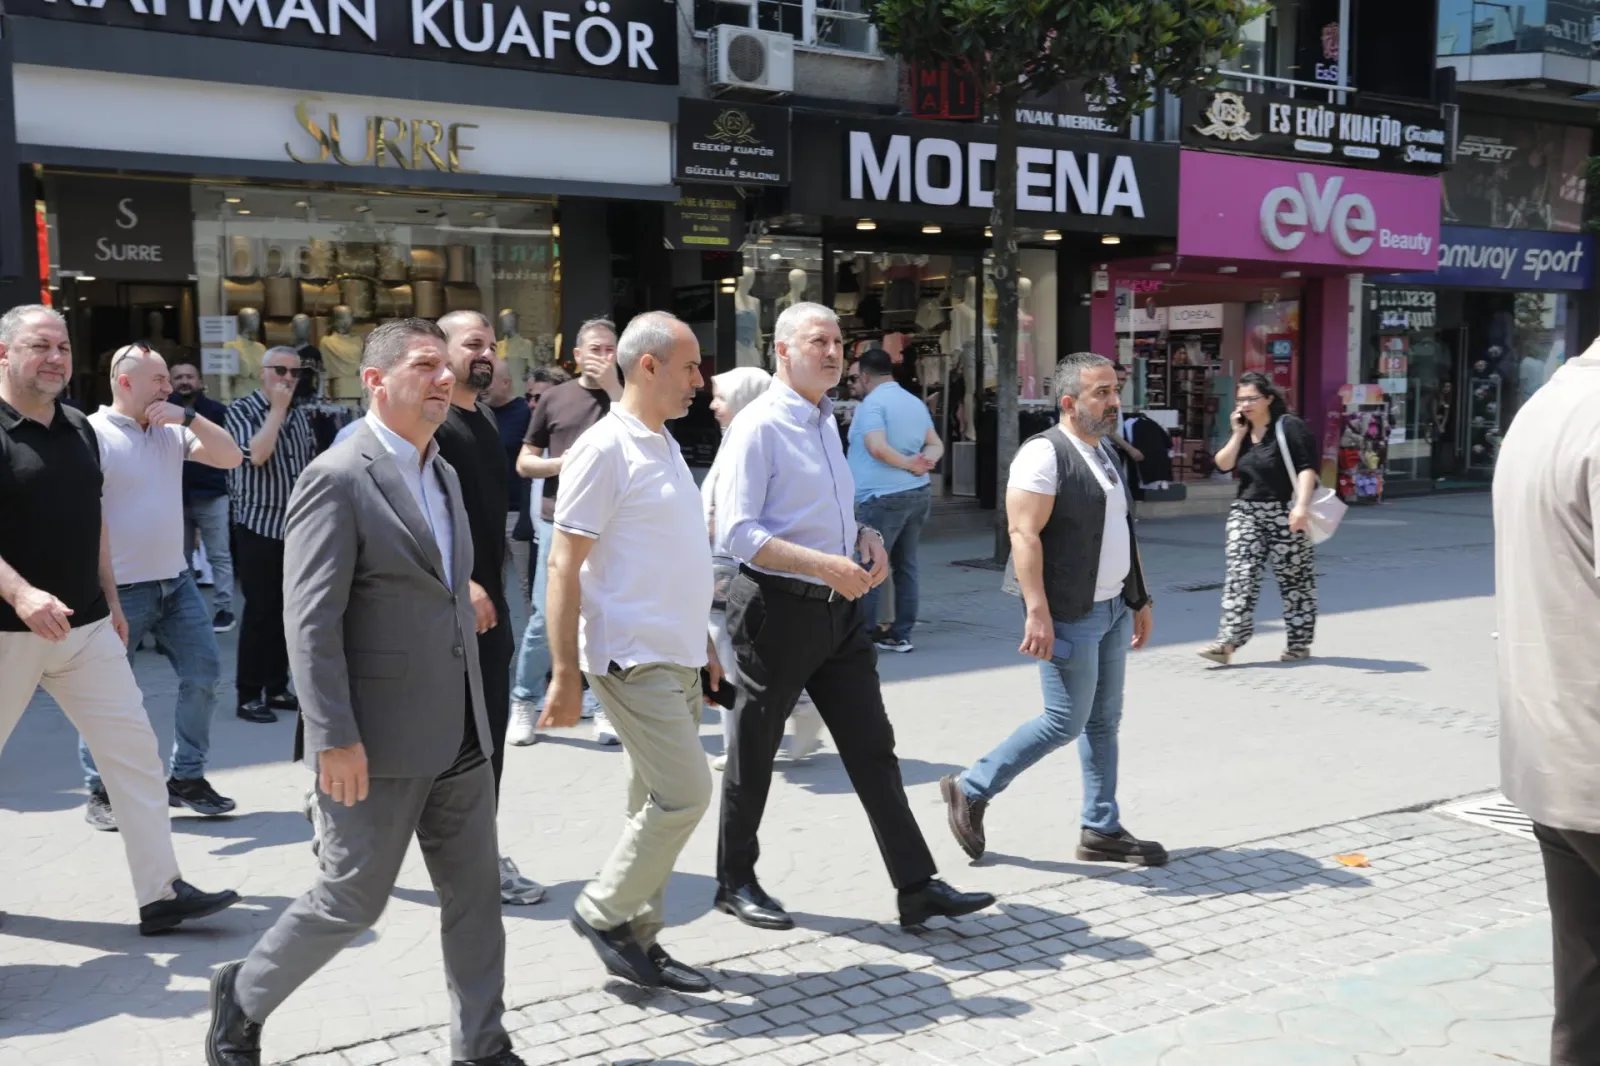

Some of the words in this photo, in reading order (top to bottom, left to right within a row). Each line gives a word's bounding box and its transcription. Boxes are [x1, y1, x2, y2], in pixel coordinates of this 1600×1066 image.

[412, 0, 659, 71] KUAFÖR
[284, 95, 480, 175] SURRE
[1269, 103, 1291, 134] ES
[1296, 105, 1335, 138] EKİP
[1339, 112, 1401, 147] KUAFÖR
[729, 157, 739, 166] &
[733, 146, 774, 157] KUAFÖR
[685, 164, 736, 178] GÜZELLİK
[739, 170, 781, 181] SALONU
[115, 197, 139, 230] S
[1260, 171, 1377, 256] eve
[94, 236, 164, 262] SURRE
[1379, 228, 1433, 256] Beauty
[1522, 241, 1584, 281] sport
